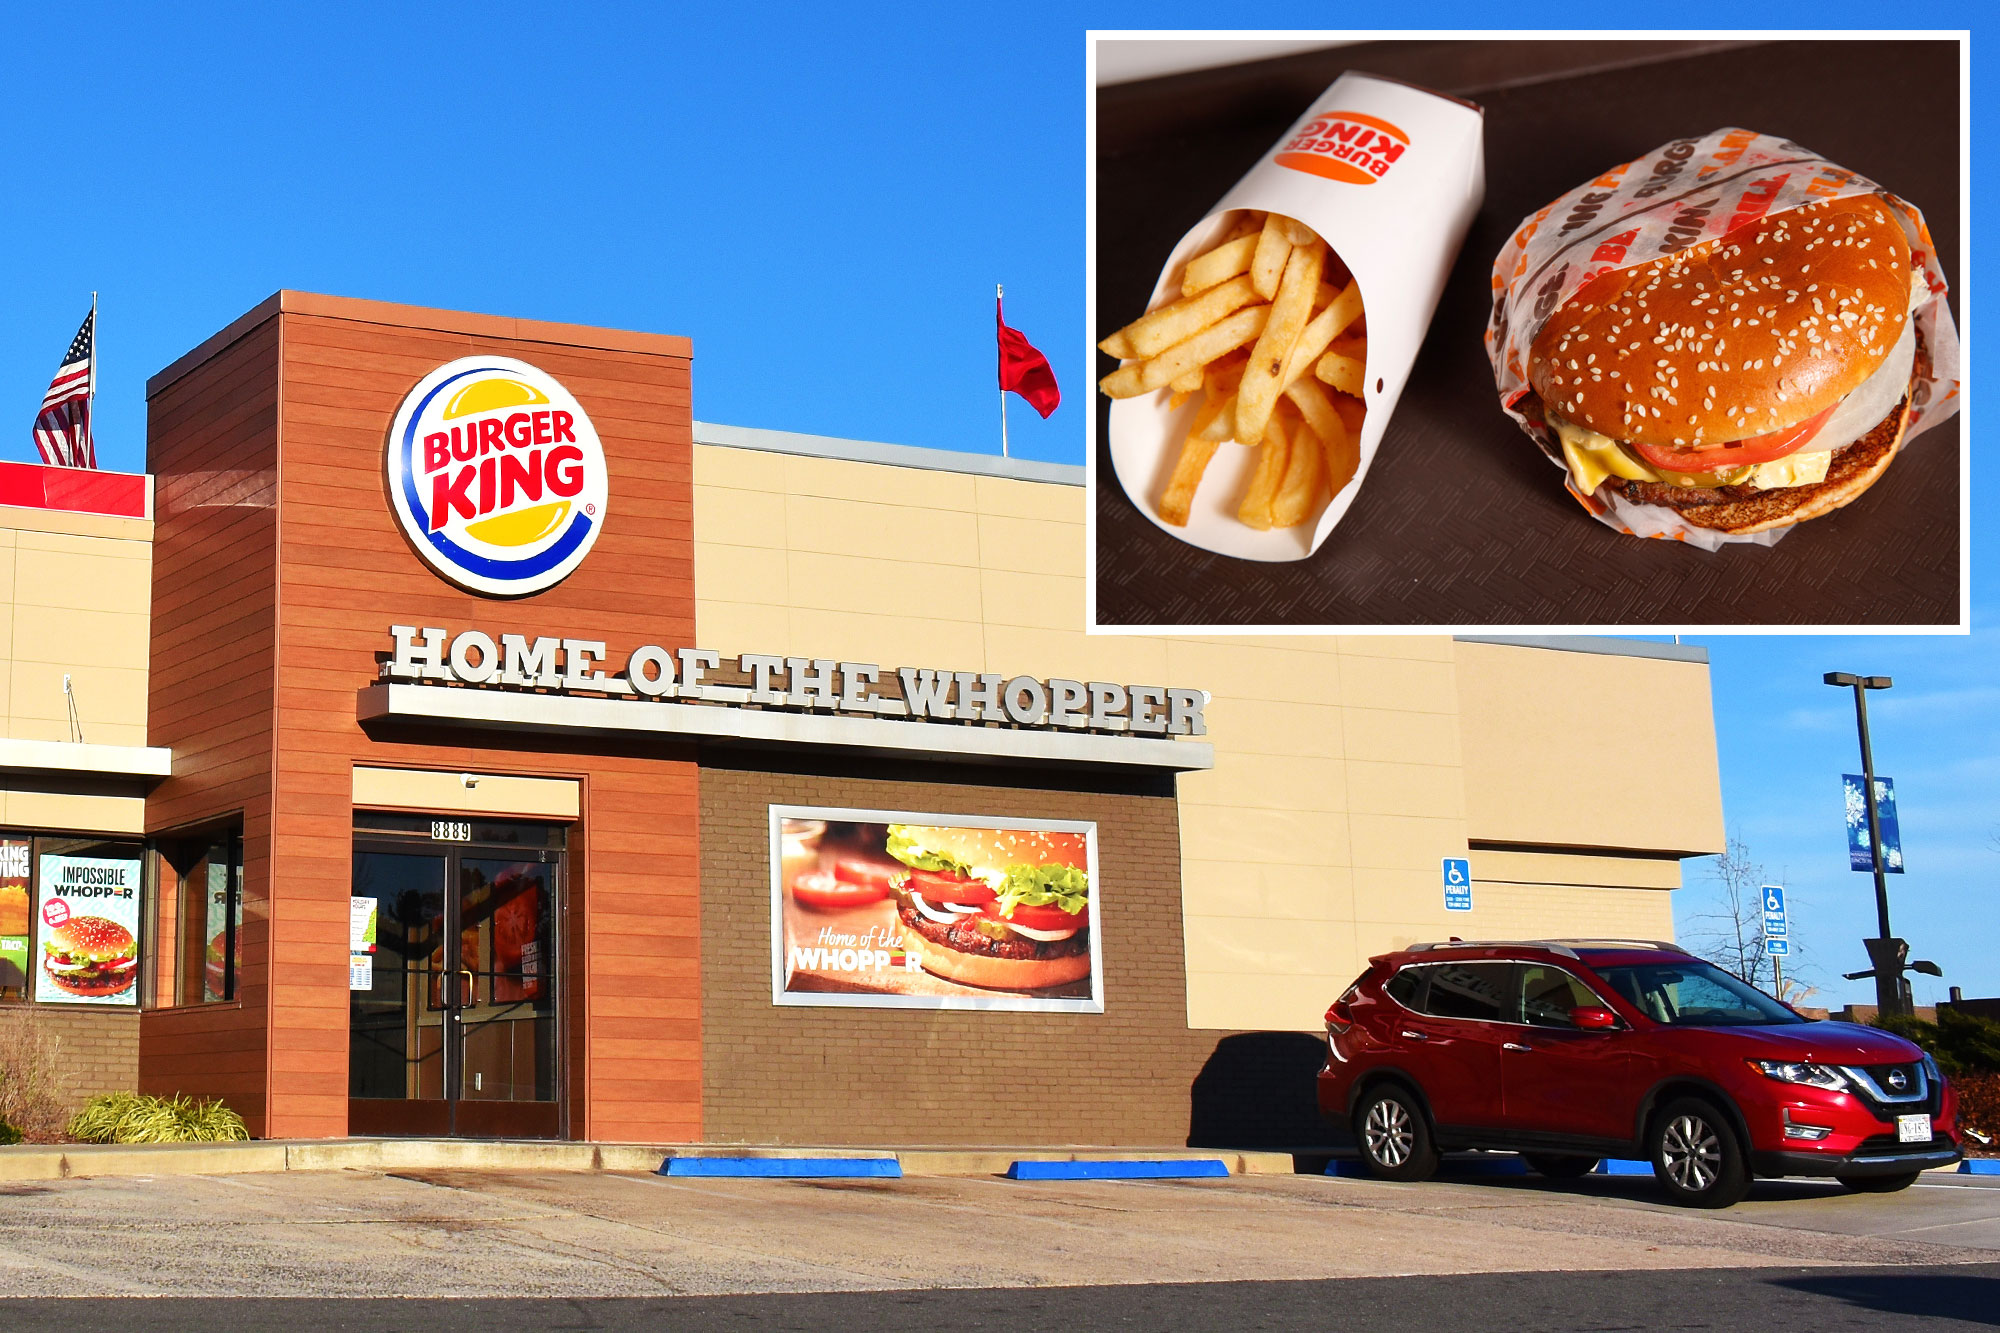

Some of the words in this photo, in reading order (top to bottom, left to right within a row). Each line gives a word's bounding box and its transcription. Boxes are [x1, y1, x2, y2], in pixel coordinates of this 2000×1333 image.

[1283, 138, 1390, 177] BURGER
[1296, 121, 1406, 163] KING
[423, 410, 576, 475] BURGER
[431, 445, 584, 531] KING
[390, 625, 606, 689] HOME
[626, 645, 720, 698] OF
[741, 653, 879, 713] THE
[897, 666, 1207, 736] WHOPPER
[433, 821, 469, 840] 8889
[62, 865, 126, 886] IMPOSSIBLE
[817, 926, 857, 946] Home
[860, 925, 878, 950] of
[878, 926, 904, 948] the
